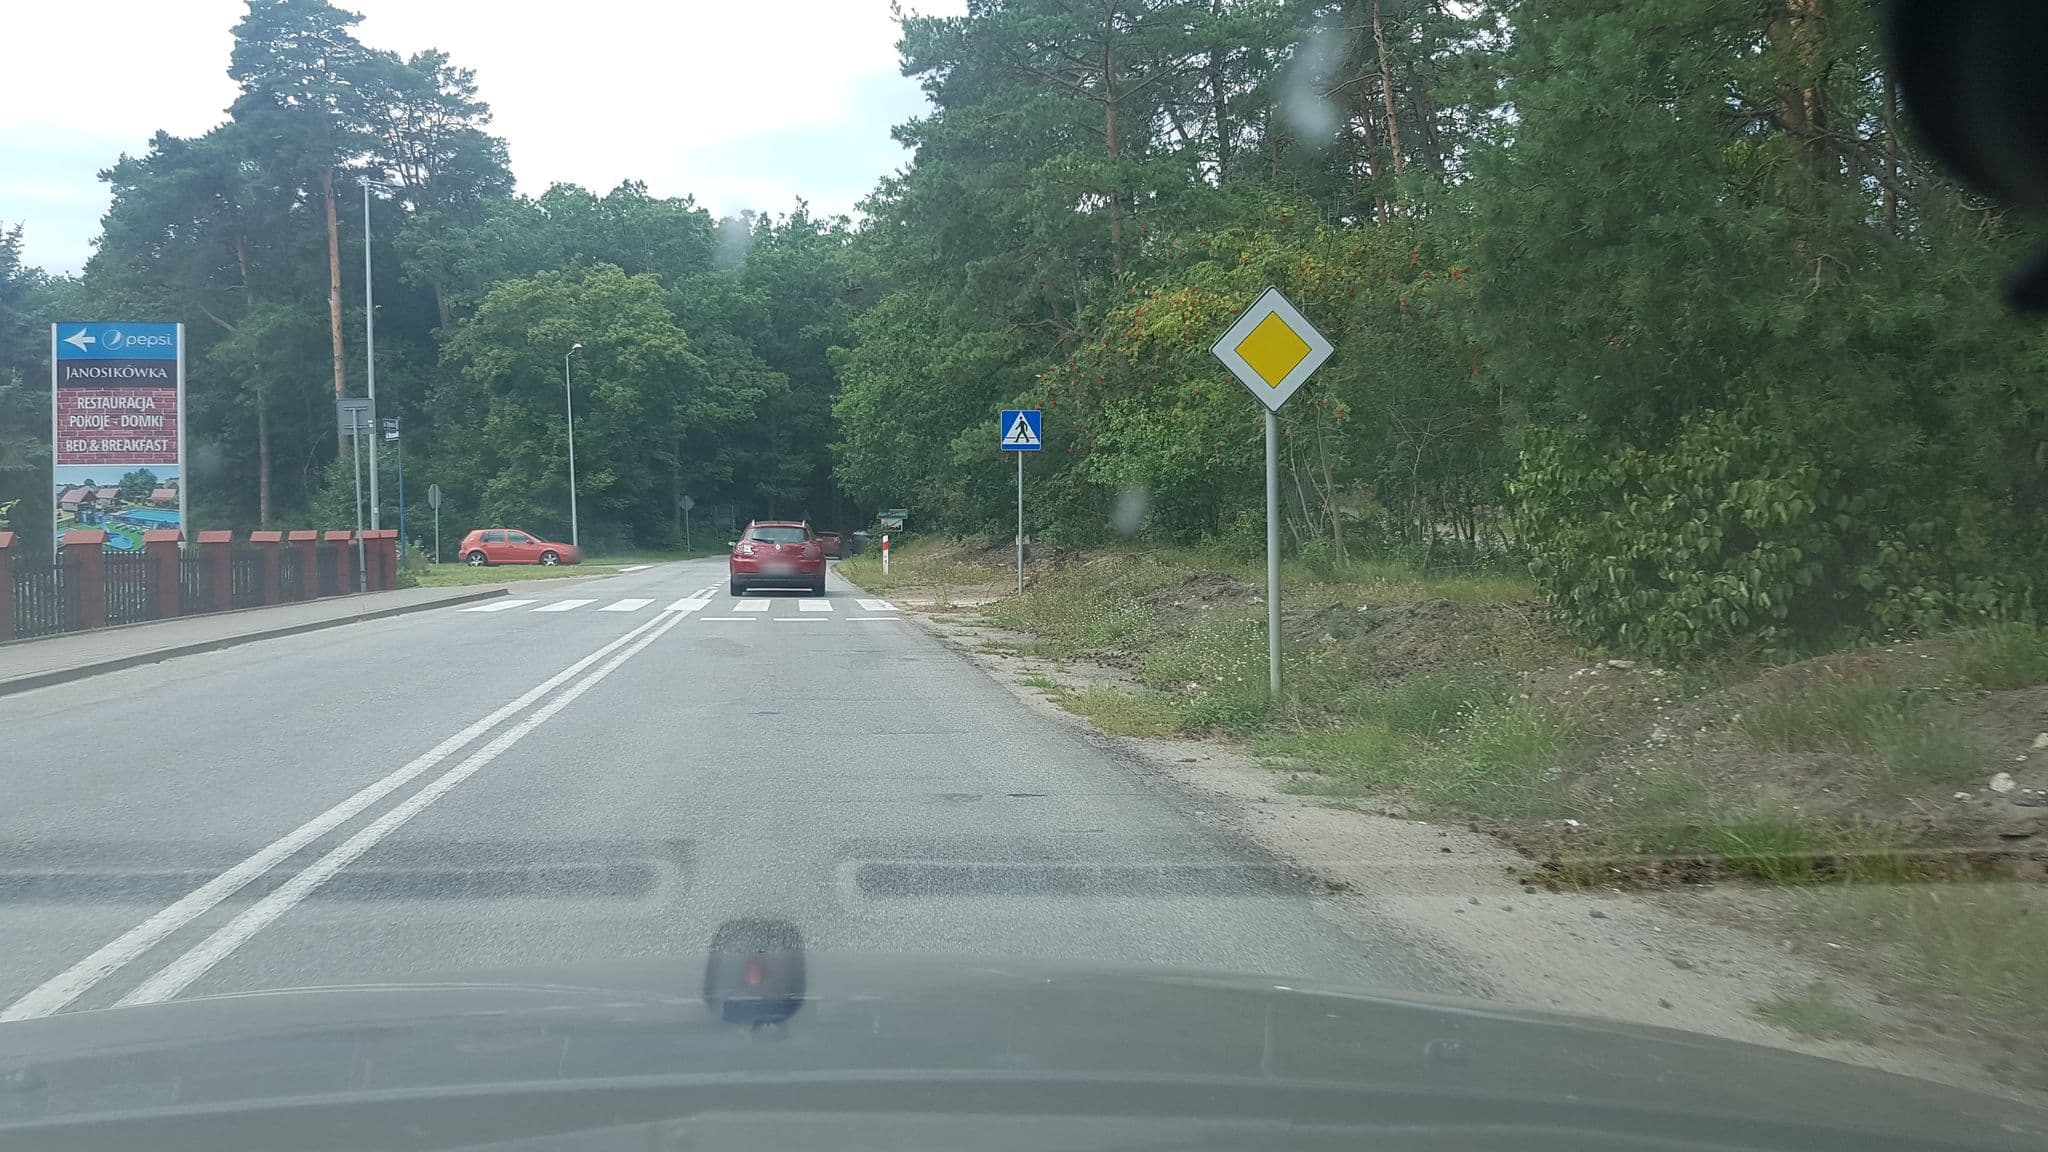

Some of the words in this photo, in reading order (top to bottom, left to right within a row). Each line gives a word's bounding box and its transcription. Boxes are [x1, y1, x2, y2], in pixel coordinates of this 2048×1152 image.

[126, 333, 173, 348] pepsi
[66, 364, 168, 380] JANOSIKÓWKA
[77, 396, 155, 411] RESTAURACJA
[69, 415, 110, 430] POKOJE
[121, 415, 163, 427] DOMKI
[66, 439, 87, 452] BED
[90, 439, 100, 452] &
[102, 439, 168, 452] BREAKFAST
